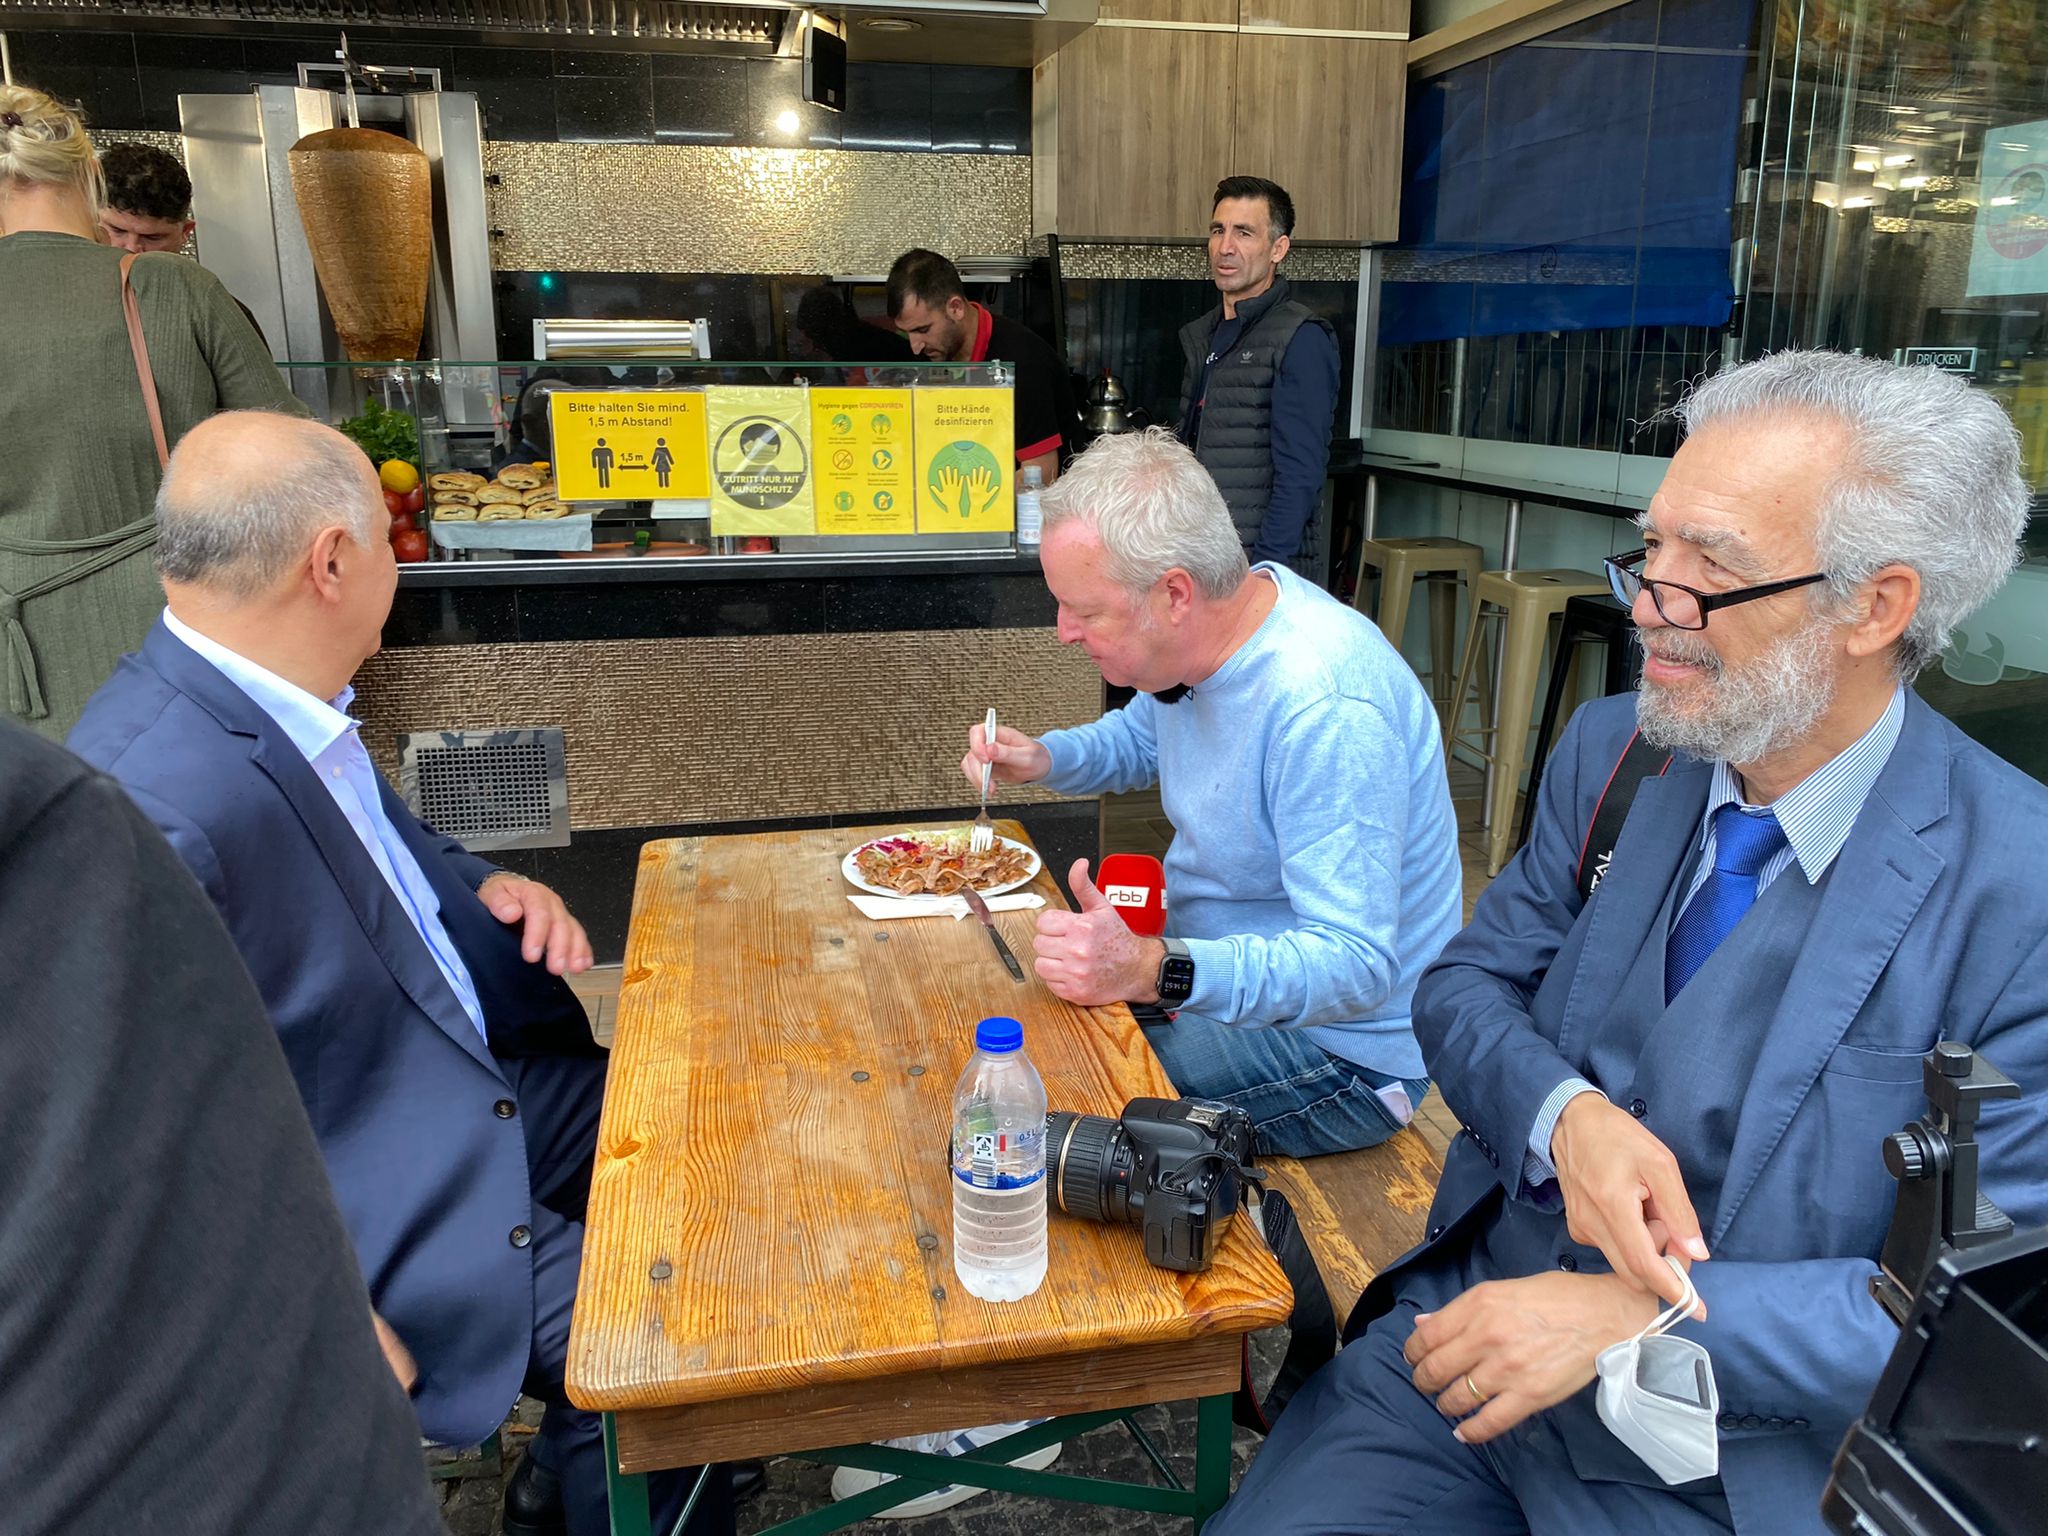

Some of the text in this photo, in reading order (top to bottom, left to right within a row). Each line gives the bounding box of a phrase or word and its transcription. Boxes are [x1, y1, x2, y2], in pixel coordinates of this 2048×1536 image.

[1916, 352, 1962, 365] DRÜCKEN
[568, 402, 690, 413] Bitte halten Sie mind.
[818, 402, 841, 410] Hygiene
[936, 403, 991, 414] Bitte Hände
[588, 416, 673, 428] 1,5 m Abstand!
[934, 417, 994, 427] desinfizieren
[620, 453, 644, 462] 1,5 m
[723, 475, 800, 484] ZUTRITT NUR MIT
[730, 485, 794, 494] MUNDSCHUTZ
[1108, 890, 1143, 903] rbb
